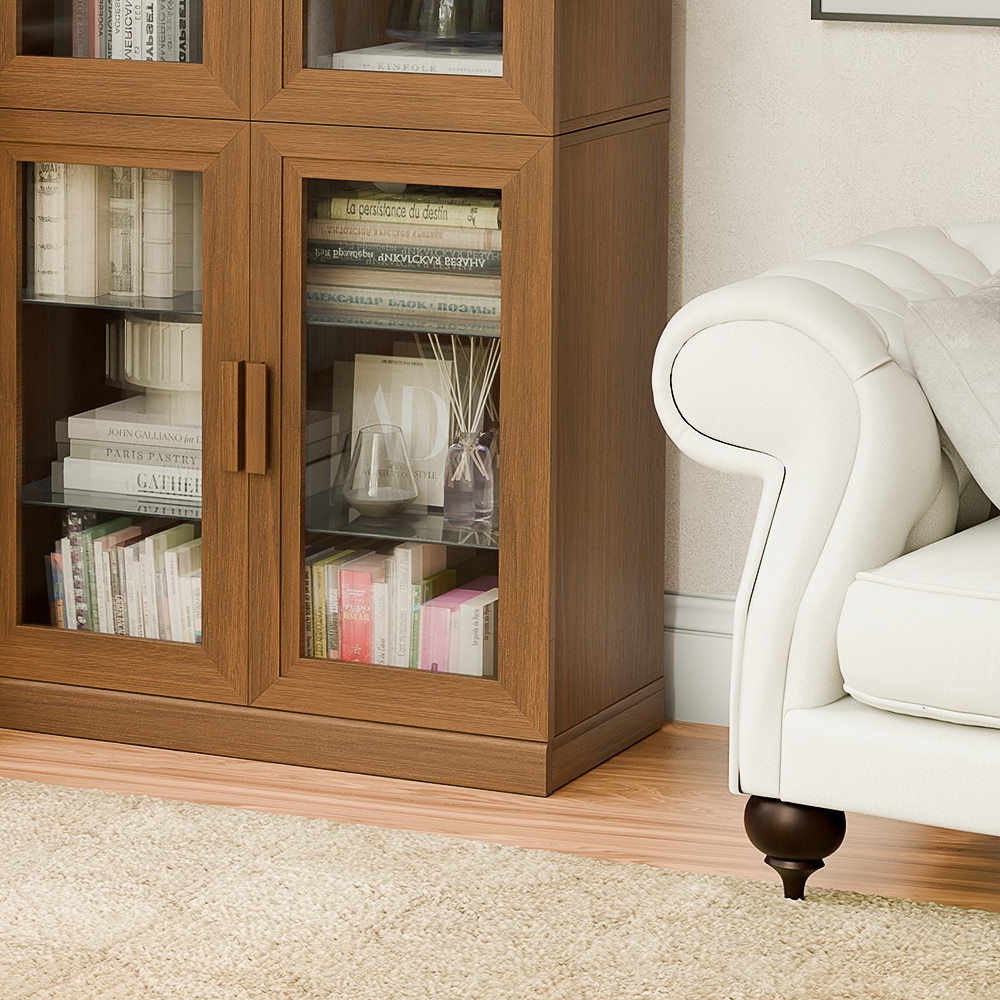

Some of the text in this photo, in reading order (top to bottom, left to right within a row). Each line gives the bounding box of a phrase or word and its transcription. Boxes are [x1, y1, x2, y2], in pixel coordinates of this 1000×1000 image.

[377, 62, 437, 72] KINFOLK
[346, 199, 356, 214] La
[358, 201, 406, 220] persistance
[409, 202, 420, 219] du
[423, 205, 448, 221] destin
[388, 298, 427, 310] БЛОК
[437, 302, 496, 315] ПОЭМЫ
[357, 383, 450, 461] AD
[107, 427, 195, 444] JOHN GALLIANO for
[106, 448, 198, 465] PARIS PASTRY
[414, 471, 438, 479] STYLE
[472, 627, 480, 640] guide
